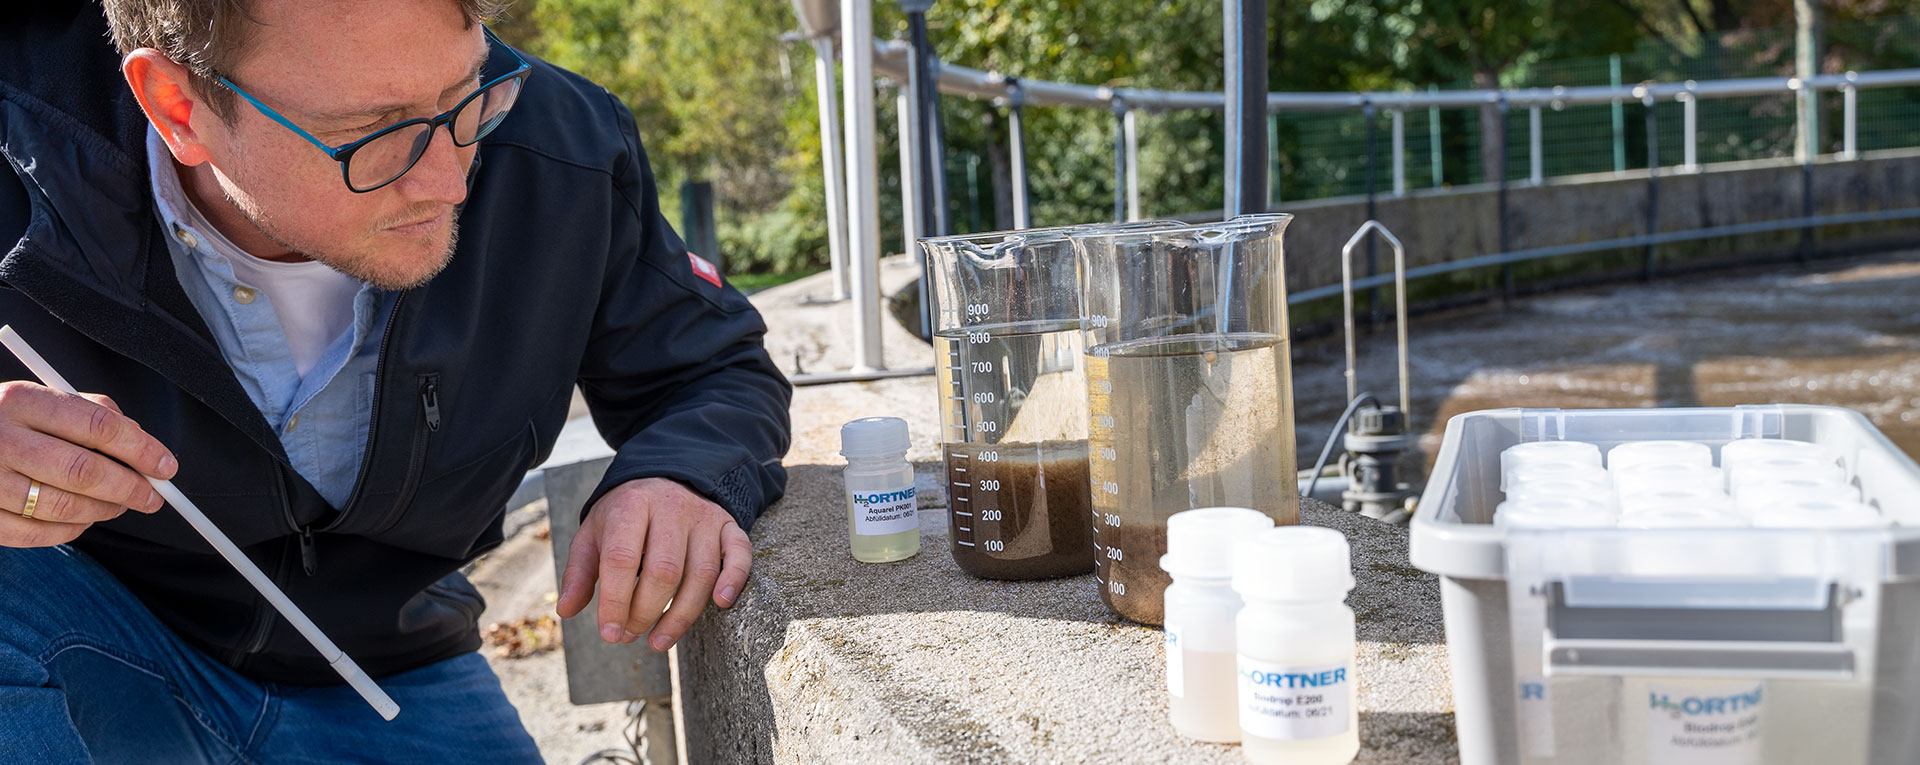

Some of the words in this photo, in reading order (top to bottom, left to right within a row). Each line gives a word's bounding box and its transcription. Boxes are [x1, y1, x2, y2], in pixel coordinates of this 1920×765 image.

[968, 303, 989, 315] 900
[1091, 314, 1108, 328] 900
[969, 332, 991, 344] 800
[1093, 347, 1110, 360] 800
[971, 362, 993, 373] 700
[974, 392, 995, 404] 600
[976, 421, 996, 432] 500
[978, 450, 998, 462] 400
[1100, 447, 1117, 461] 500
[980, 480, 1000, 491] 300
[1102, 481, 1119, 495] 400
[868, 506, 894, 514] Aquarel
[982, 509, 1002, 521] 200
[1104, 513, 1121, 527] 300
[984, 540, 1004, 551] 100
[1106, 546, 1123, 561] 200
[1109, 581, 1125, 595] 100
[1240, 667, 1346, 688] ORTNER
